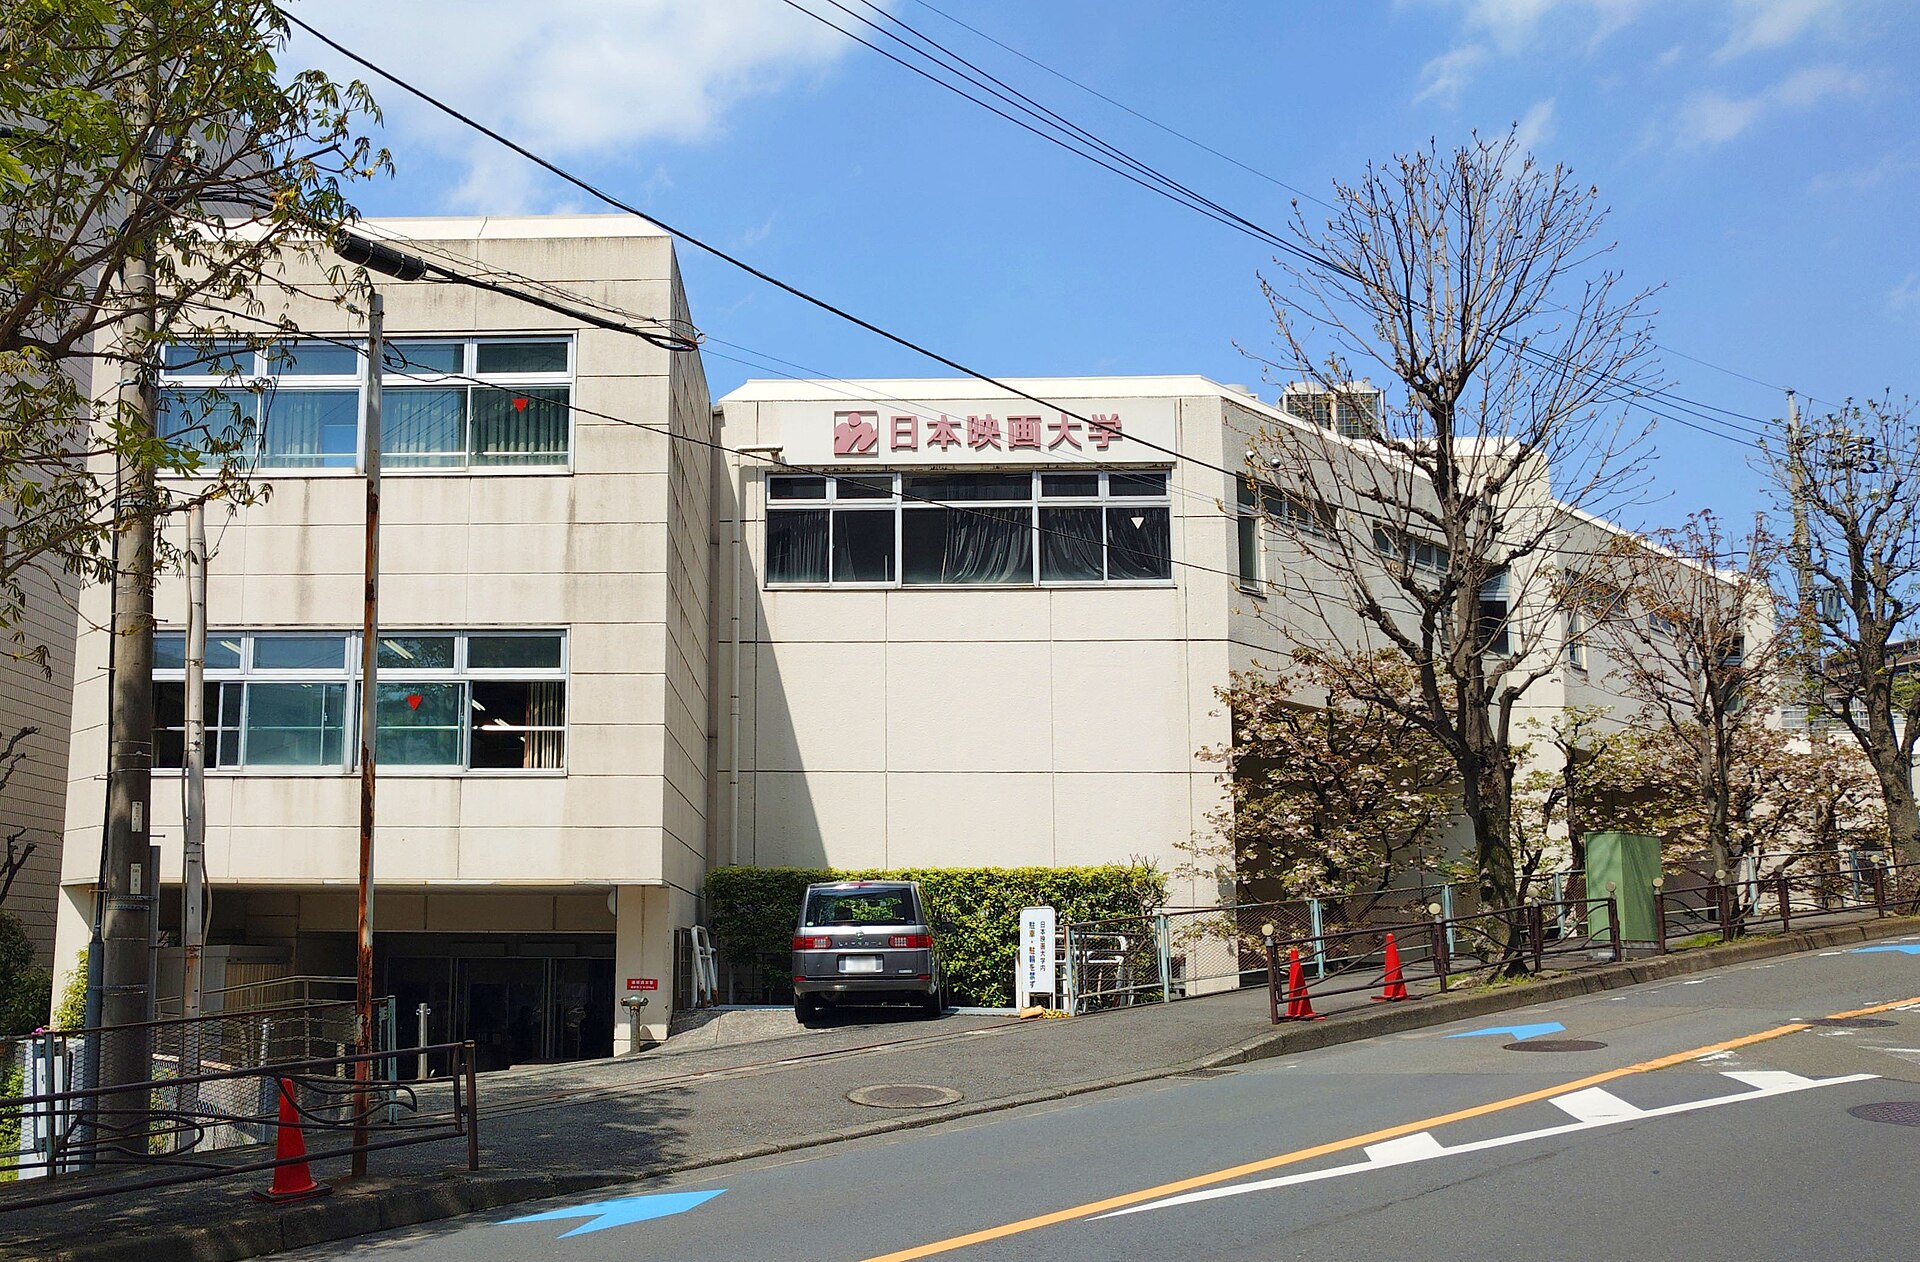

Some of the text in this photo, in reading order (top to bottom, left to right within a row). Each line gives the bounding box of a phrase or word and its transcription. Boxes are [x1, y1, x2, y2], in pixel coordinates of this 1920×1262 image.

[890, 413, 1123, 451] 日本映画大学
